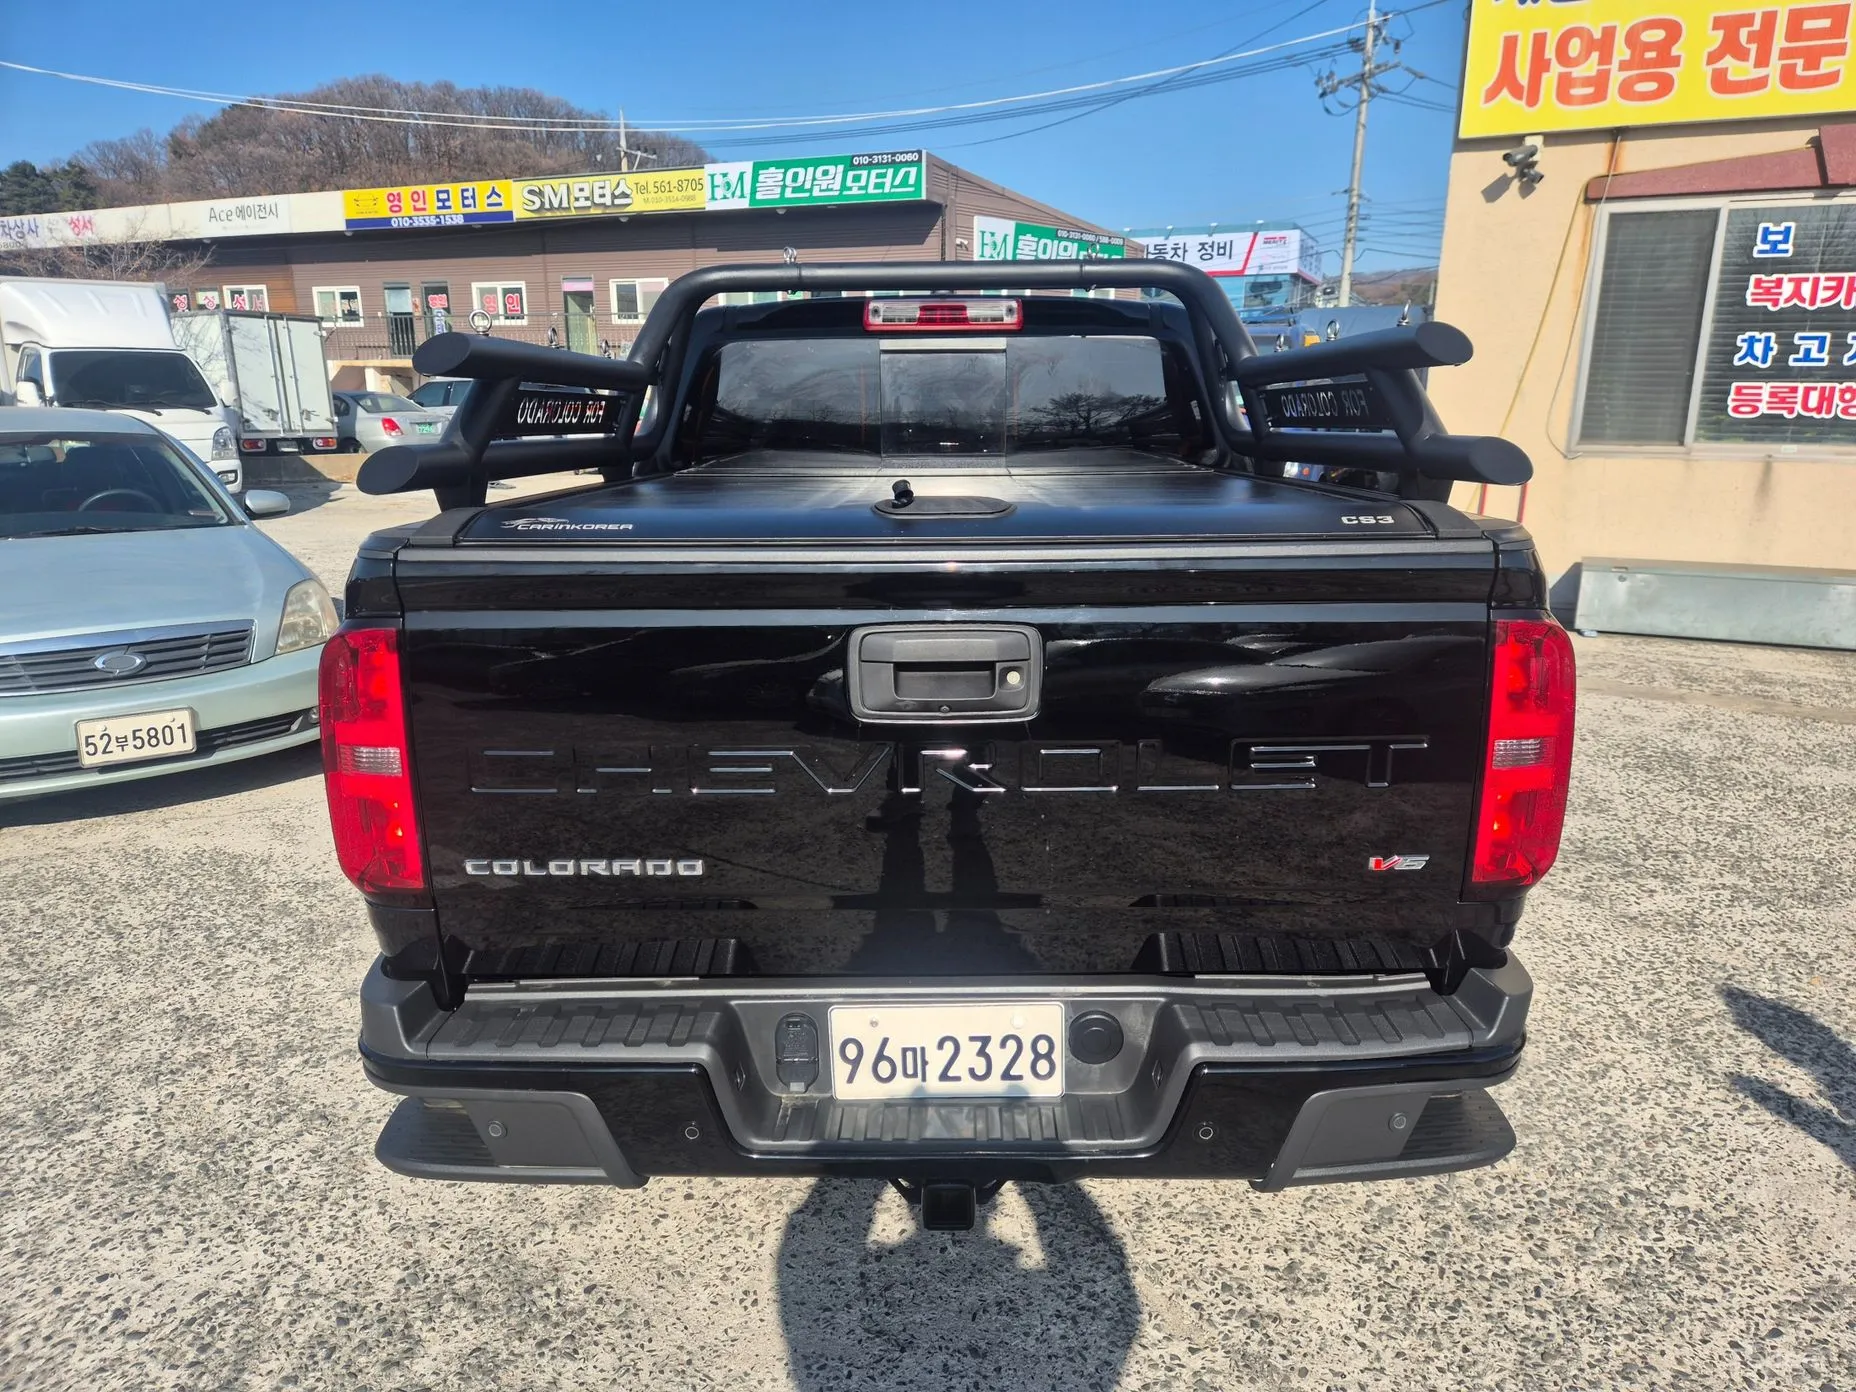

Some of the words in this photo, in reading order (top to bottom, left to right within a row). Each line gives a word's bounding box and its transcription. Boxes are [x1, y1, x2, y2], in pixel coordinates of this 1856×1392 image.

[1482, 16, 1684, 109] 사업용
[1705, 3, 1852, 96] 전문
[755, 164, 845, 200] 홀인원
[846, 166, 918, 194] 모터스
[208, 207, 233, 222] Ace
[235, 202, 279, 220] 에이전시
[1145, 242, 1187, 261] 동차
[1198, 239, 1233, 261] 정비
[1341, 515, 1395, 525] CS3
[85, 722, 187, 756] 52부5801
[467, 738, 1430, 793] CHEVROLET
[464, 859, 705, 877] COLORADO
[1368, 854, 1431, 871] V6
[838, 1033, 1058, 1085] 96마2328
